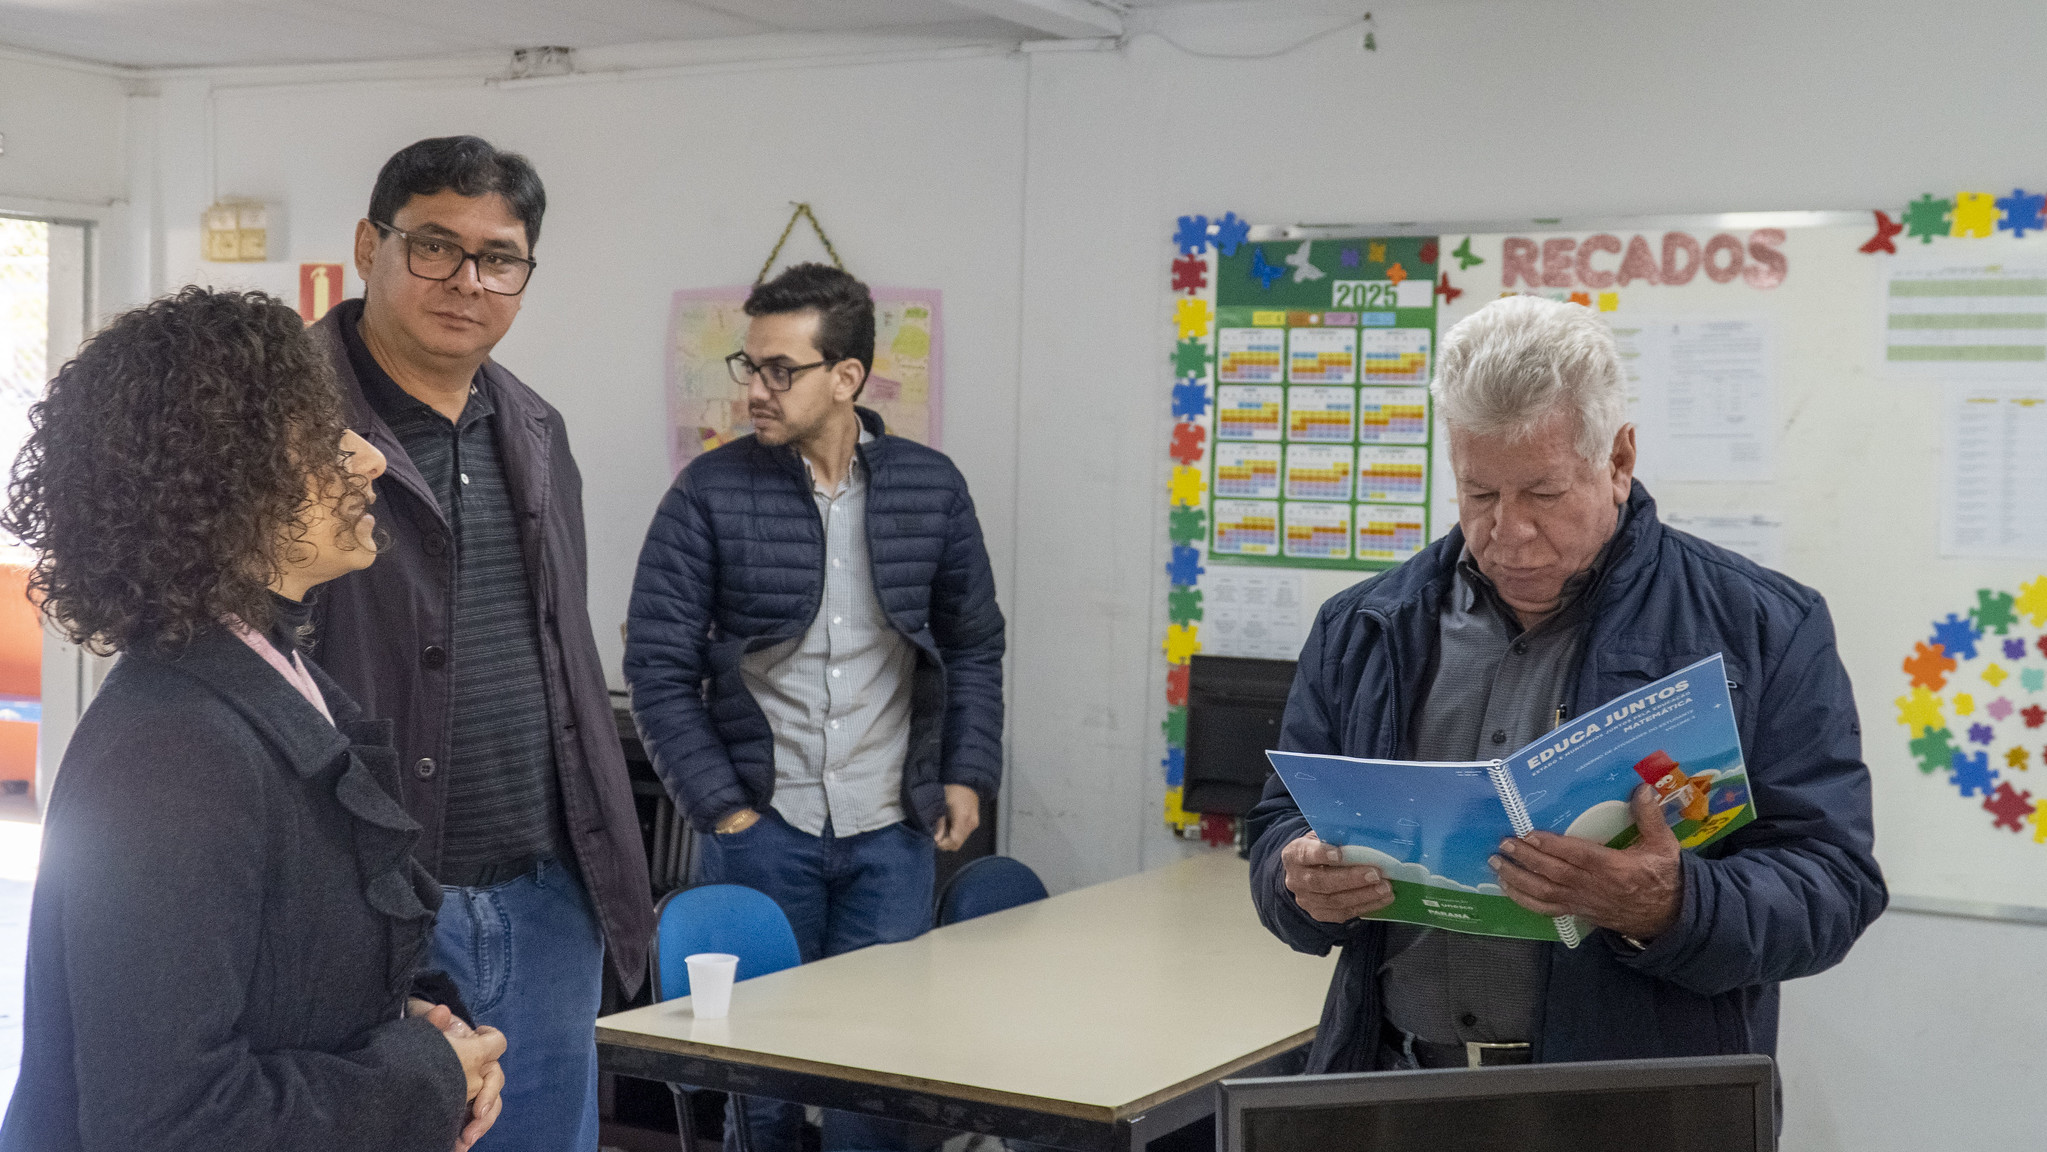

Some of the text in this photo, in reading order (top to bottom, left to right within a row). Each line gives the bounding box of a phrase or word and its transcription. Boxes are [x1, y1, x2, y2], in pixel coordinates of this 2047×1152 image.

[1501, 228, 1788, 290] RECADOS
[1337, 284, 1398, 307] 2025
[1527, 680, 1689, 770] EDUCA JUNTOS
[1624, 698, 1693, 733] MATEMÁTICA
